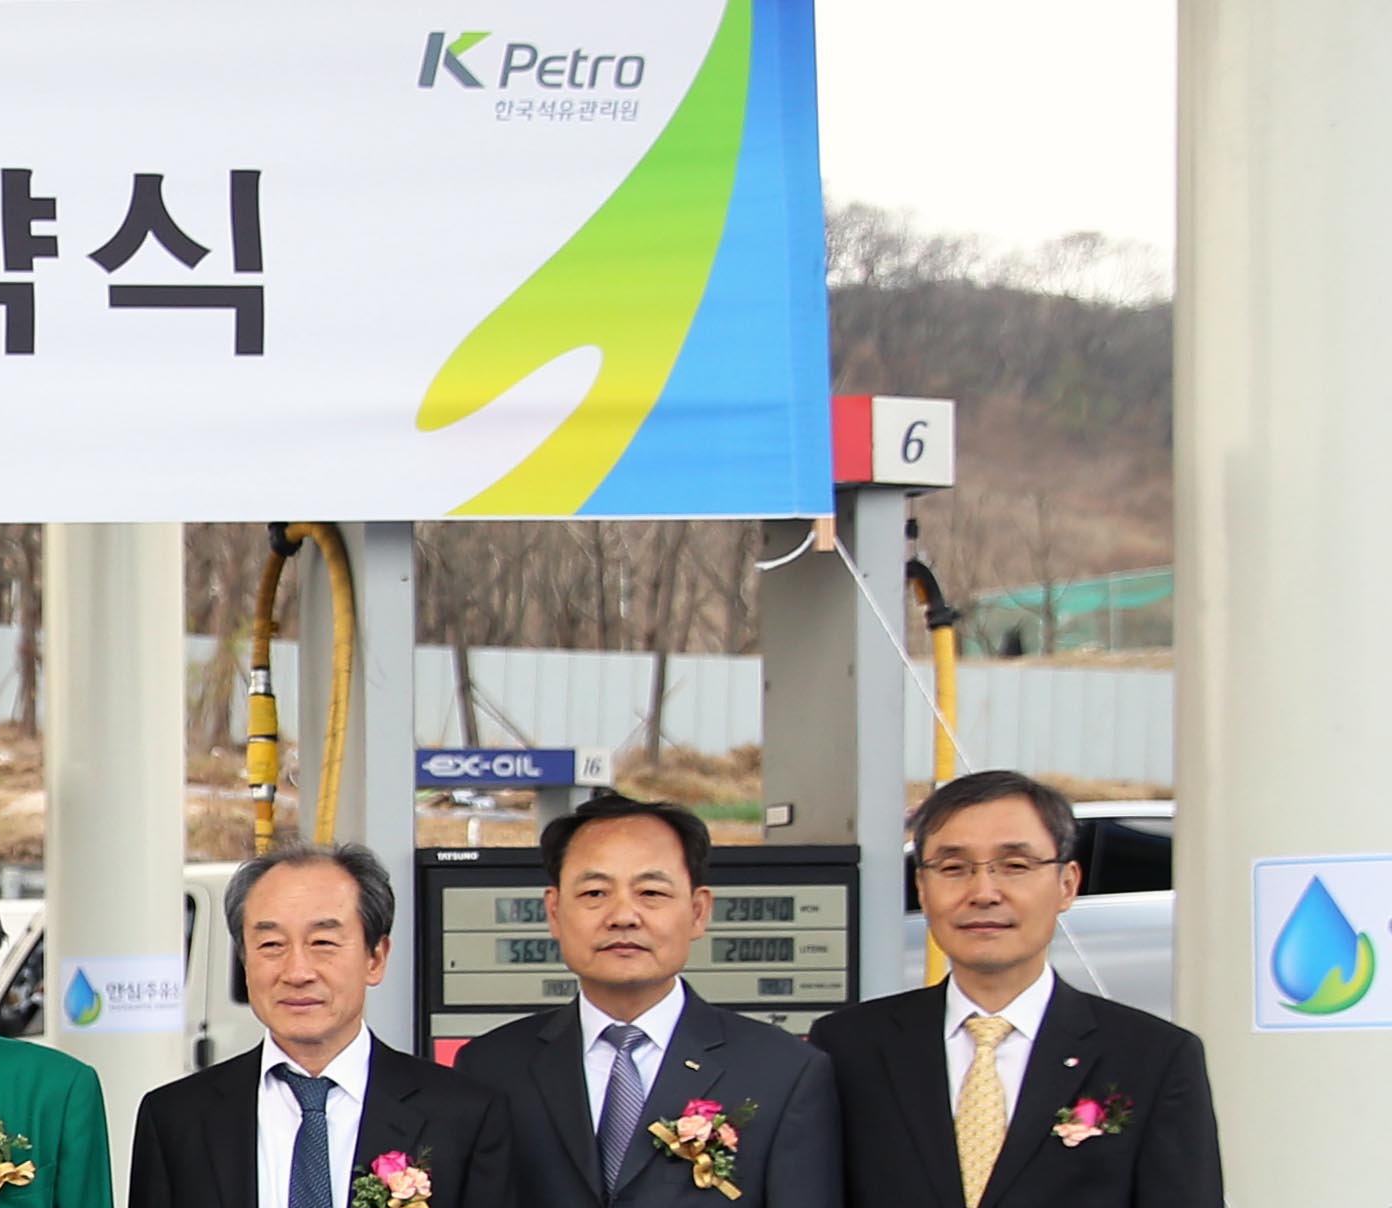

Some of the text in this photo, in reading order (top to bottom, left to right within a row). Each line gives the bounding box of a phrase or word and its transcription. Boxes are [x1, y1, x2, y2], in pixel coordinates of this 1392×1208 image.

[417, 32, 646, 89] K Petro
[493, 100, 639, 121] 한국석유관리원
[901, 420, 928, 463] 6
[583, 758, 601, 776] 16
